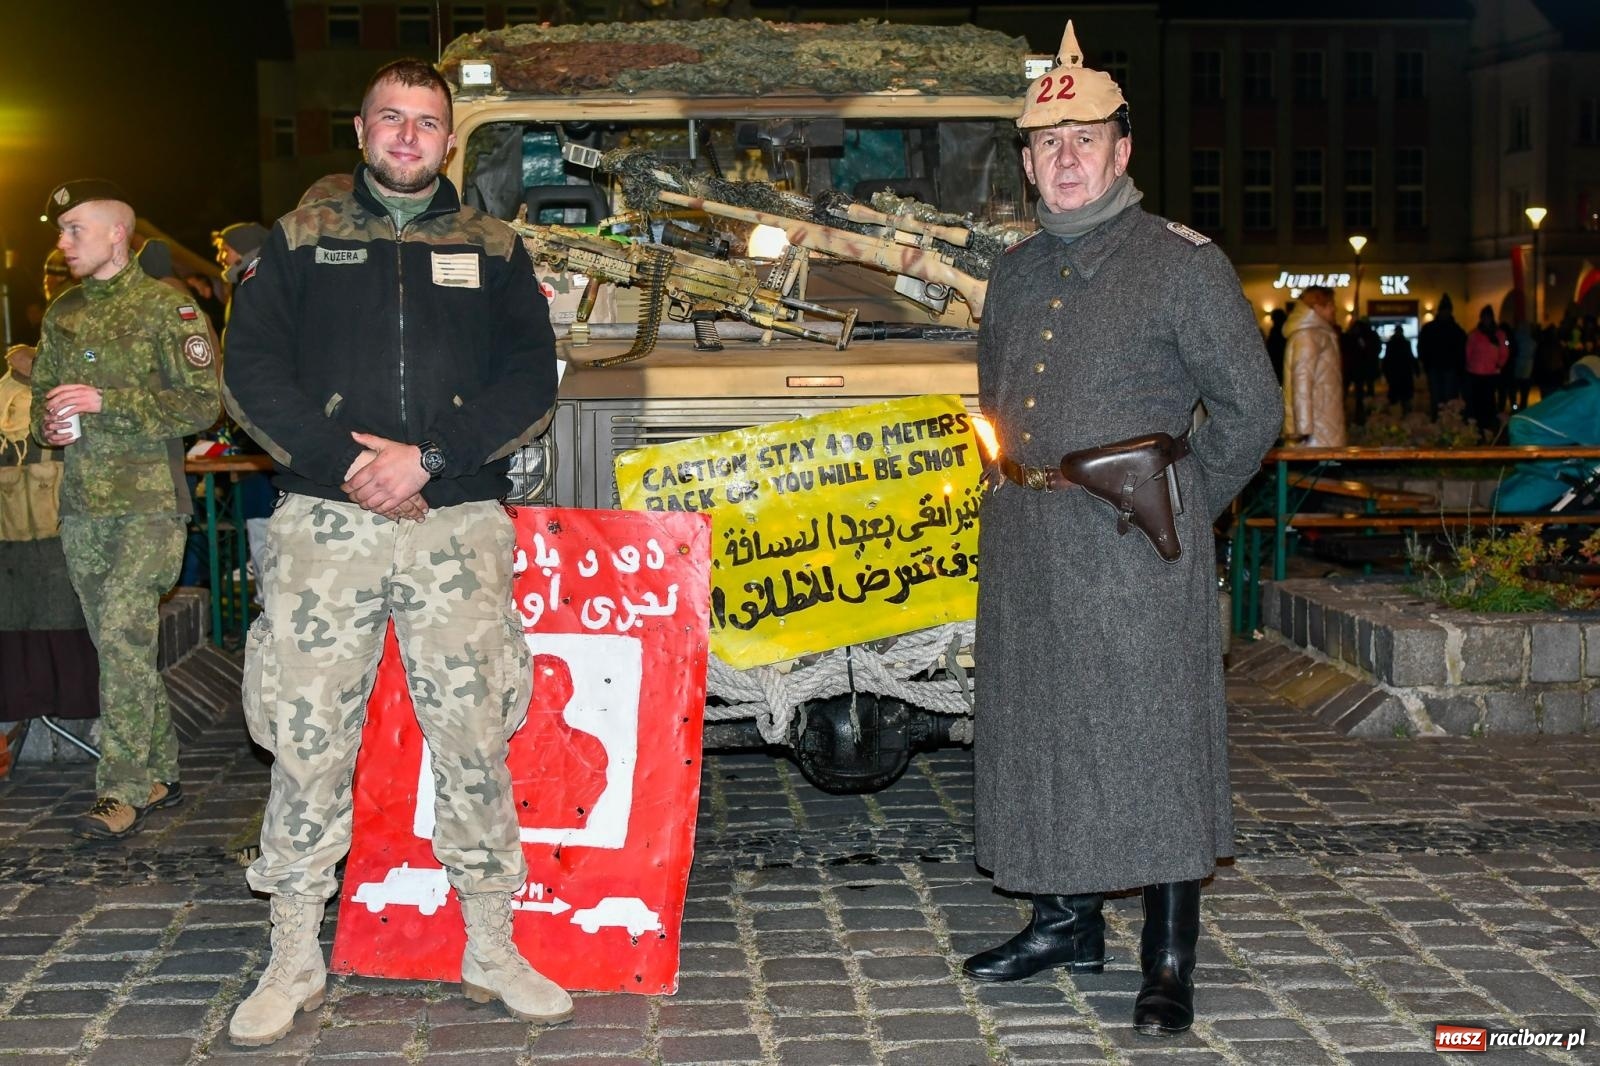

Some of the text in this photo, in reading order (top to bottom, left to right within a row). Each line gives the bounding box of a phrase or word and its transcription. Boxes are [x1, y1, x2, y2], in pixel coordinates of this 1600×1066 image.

[1036, 74, 1076, 104] 22
[323, 251, 359, 262] KUZERA
[1273, 271, 1351, 289] JUBILER
[642, 453, 747, 492] CAUTION
[757, 438, 816, 469] STAY
[881, 413, 970, 447] METERS
[645, 443, 968, 513] BACK OR YOU WILL BE SHOT
